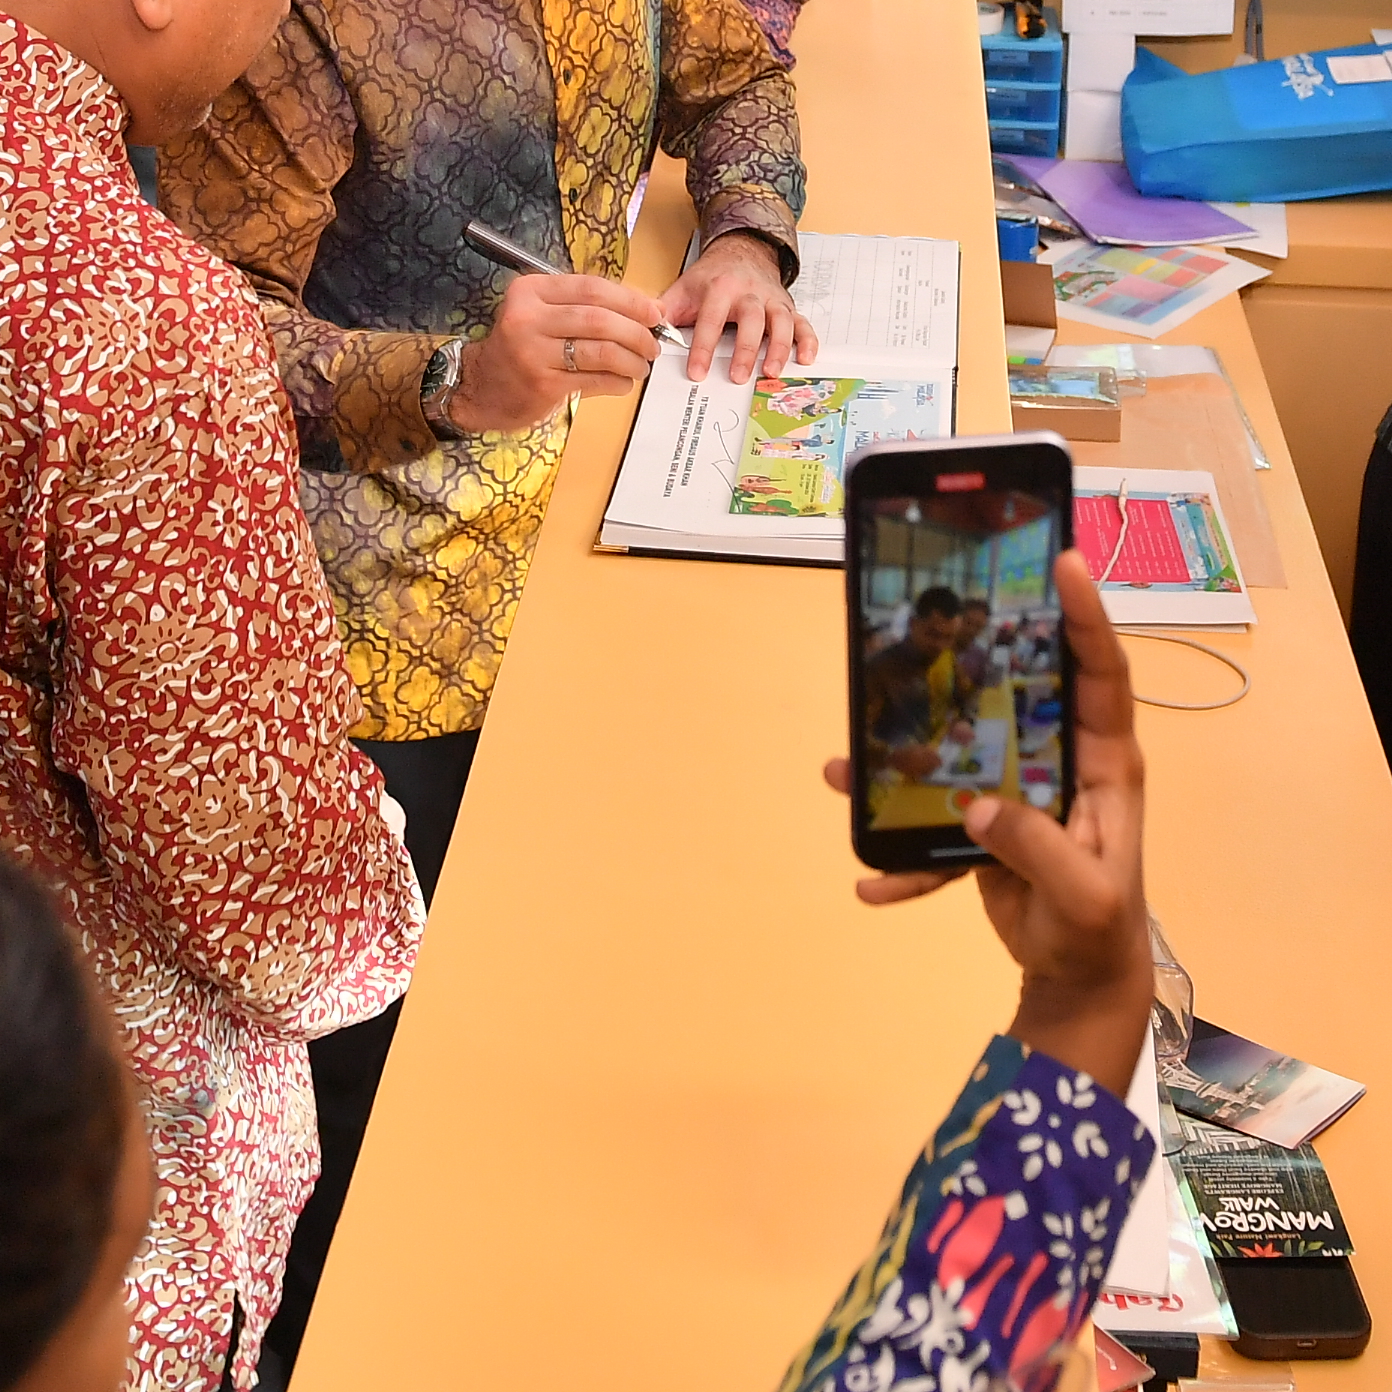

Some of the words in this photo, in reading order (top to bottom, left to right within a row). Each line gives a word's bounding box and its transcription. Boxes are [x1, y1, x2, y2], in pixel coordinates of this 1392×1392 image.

[688, 384, 699, 405] TIMBALAN
[682, 407, 693, 426] MENTERI
[698, 403, 708, 415] TUAN
[693, 416, 704, 435] KHAIRUL
[688, 436, 700, 456] FIRDAUS
[854, 430, 870, 451] MALA
[670, 463, 680, 473] SENI
[684, 457, 695, 472] AKBAR
[663, 478, 675, 497] BUDAYA
[681, 473, 691, 486] KHAN
[1218, 1196, 1280, 1212] WALK
[1199, 1210, 1335, 1233] MANGROV
